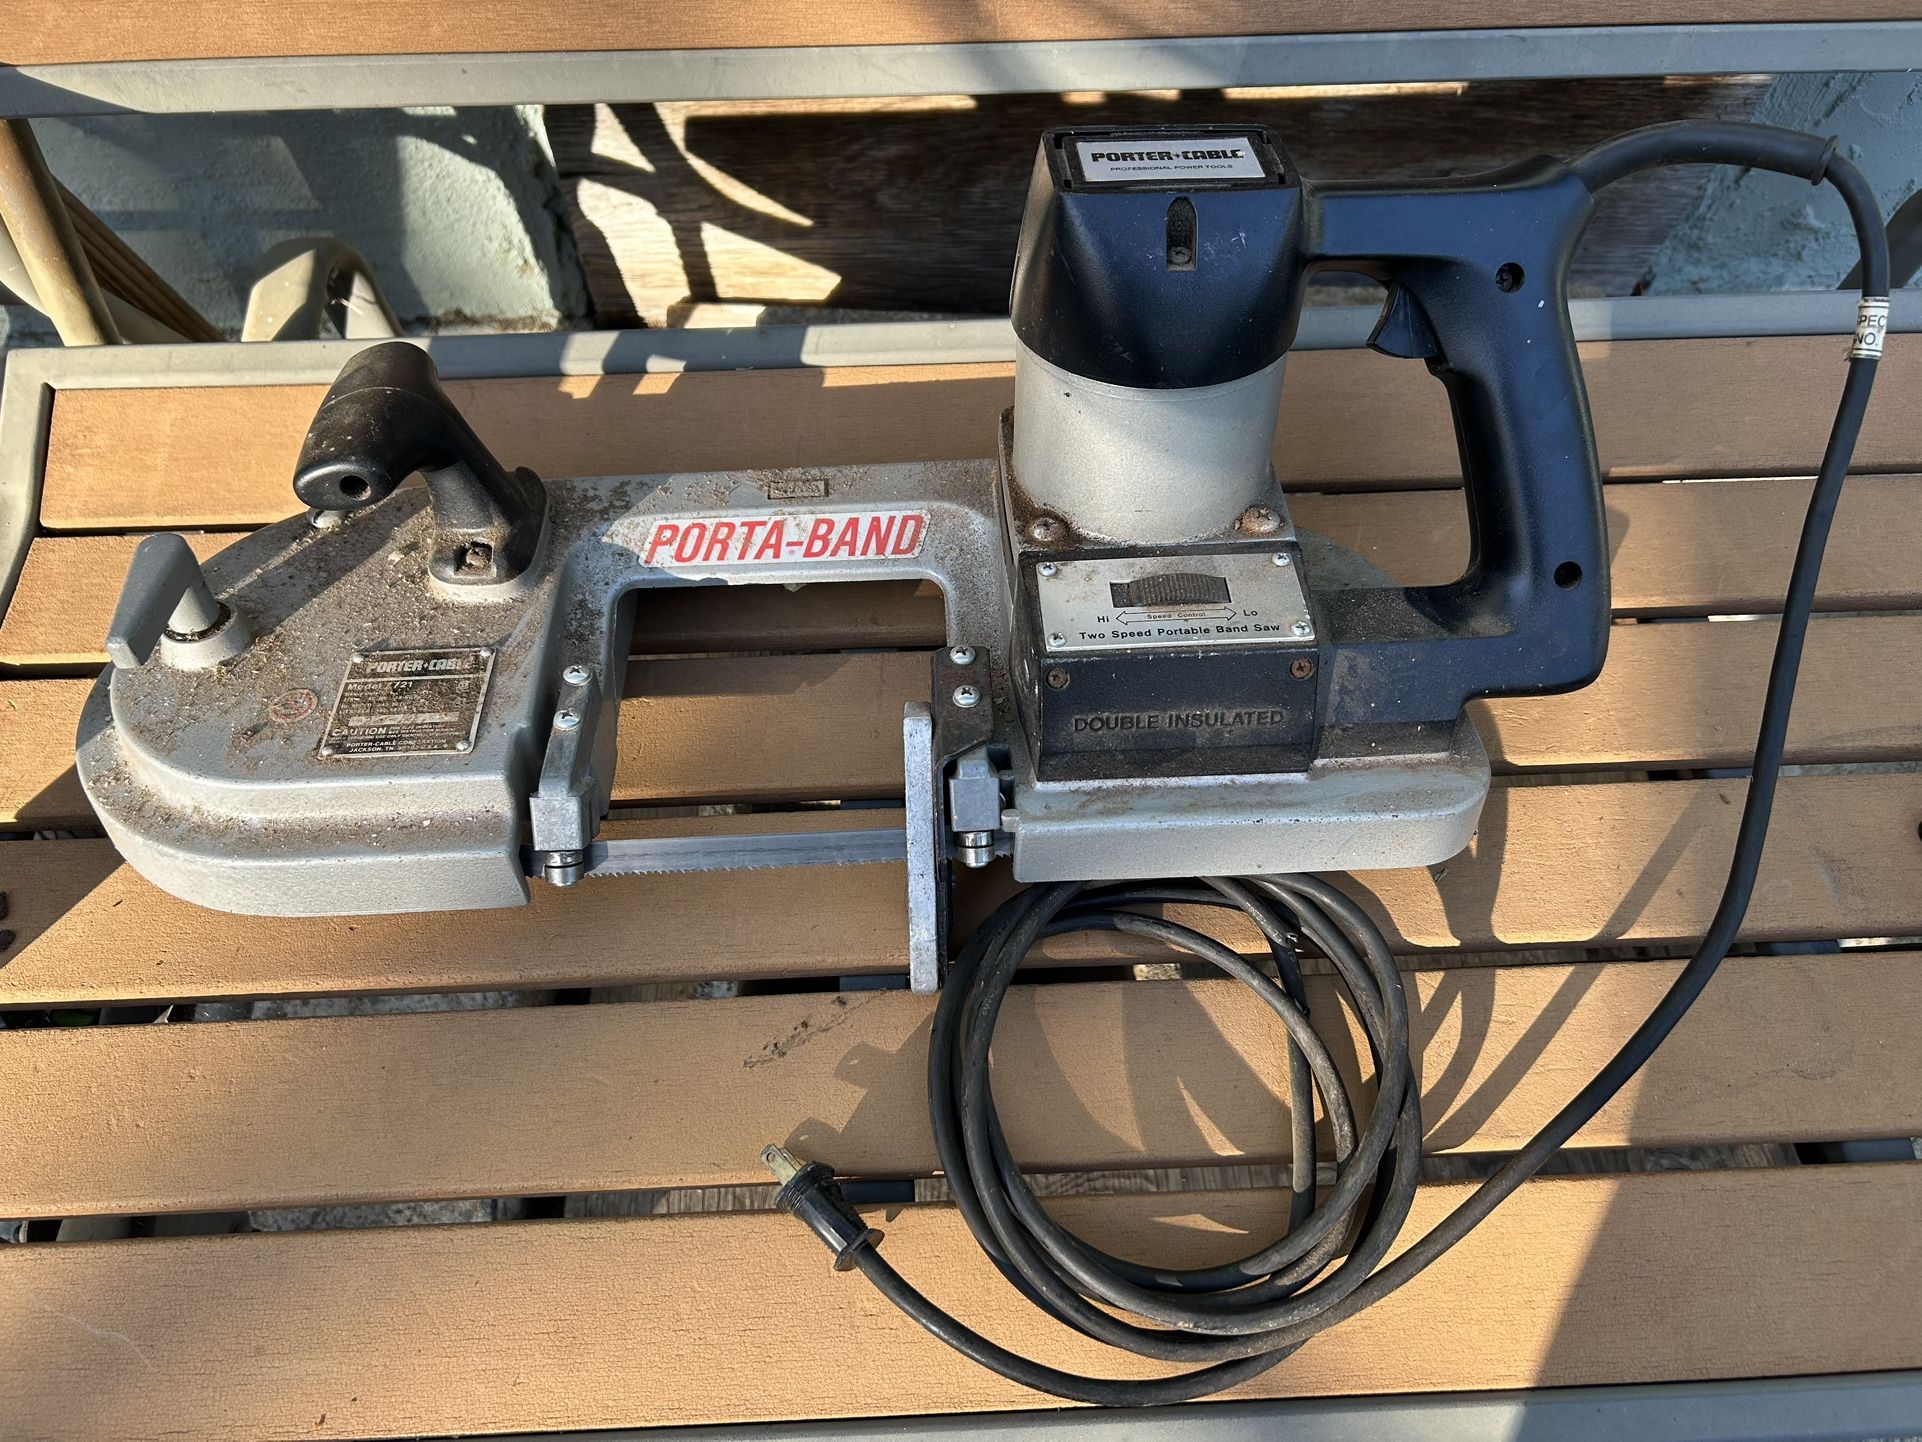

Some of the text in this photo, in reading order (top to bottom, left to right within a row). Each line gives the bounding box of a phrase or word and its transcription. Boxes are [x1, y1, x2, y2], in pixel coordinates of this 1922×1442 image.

[644, 514, 924, 564] PORTA-BAND
[1243, 609, 1258, 617] Lo
[1097, 615, 1109, 624] Hi
[1079, 622, 1280, 640] Two Speed Portable Band Saw
[347, 682, 382, 691] Model
[1074, 709, 1284, 732] DOUBLE INSULATED
[332, 726, 387, 736] CAUTION
[346, 740, 396, 748] PORTER-CABLE
